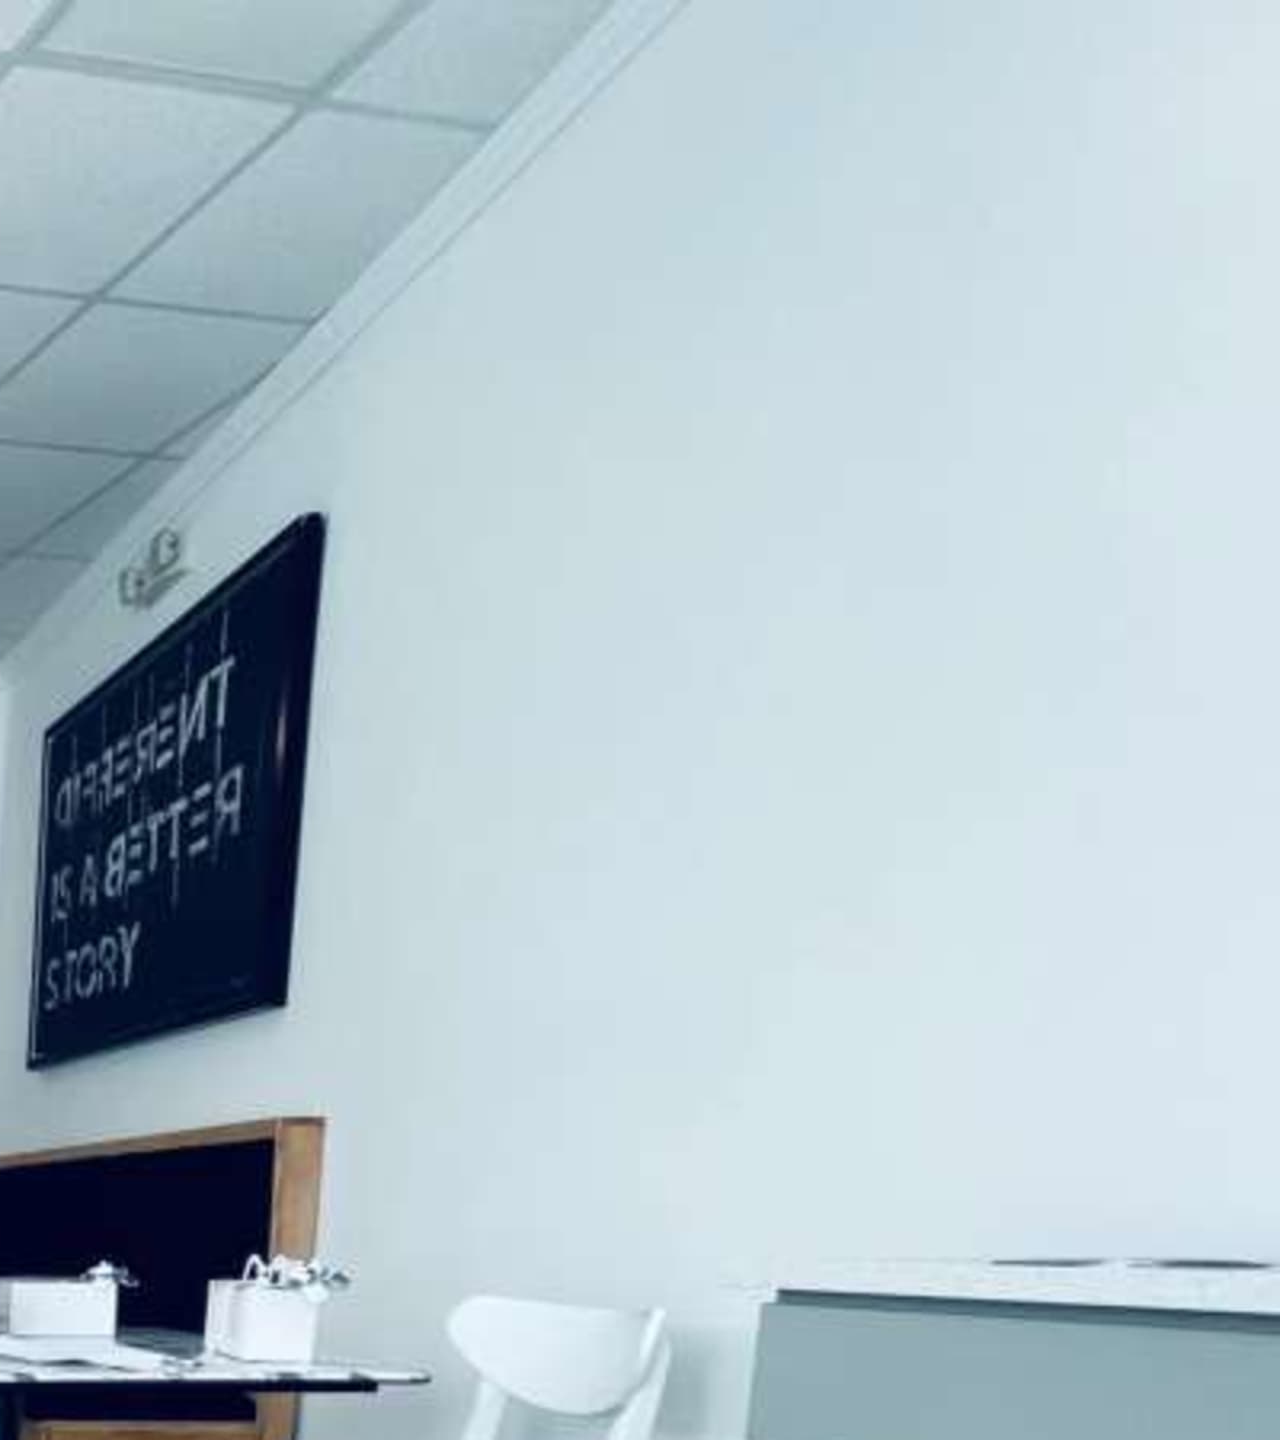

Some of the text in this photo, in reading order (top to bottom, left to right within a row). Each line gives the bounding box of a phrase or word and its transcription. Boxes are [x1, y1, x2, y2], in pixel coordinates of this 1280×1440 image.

[79, 854, 99, 909] A
[104, 764, 244, 897] BETTER
[44, 921, 141, 1011] STORY
